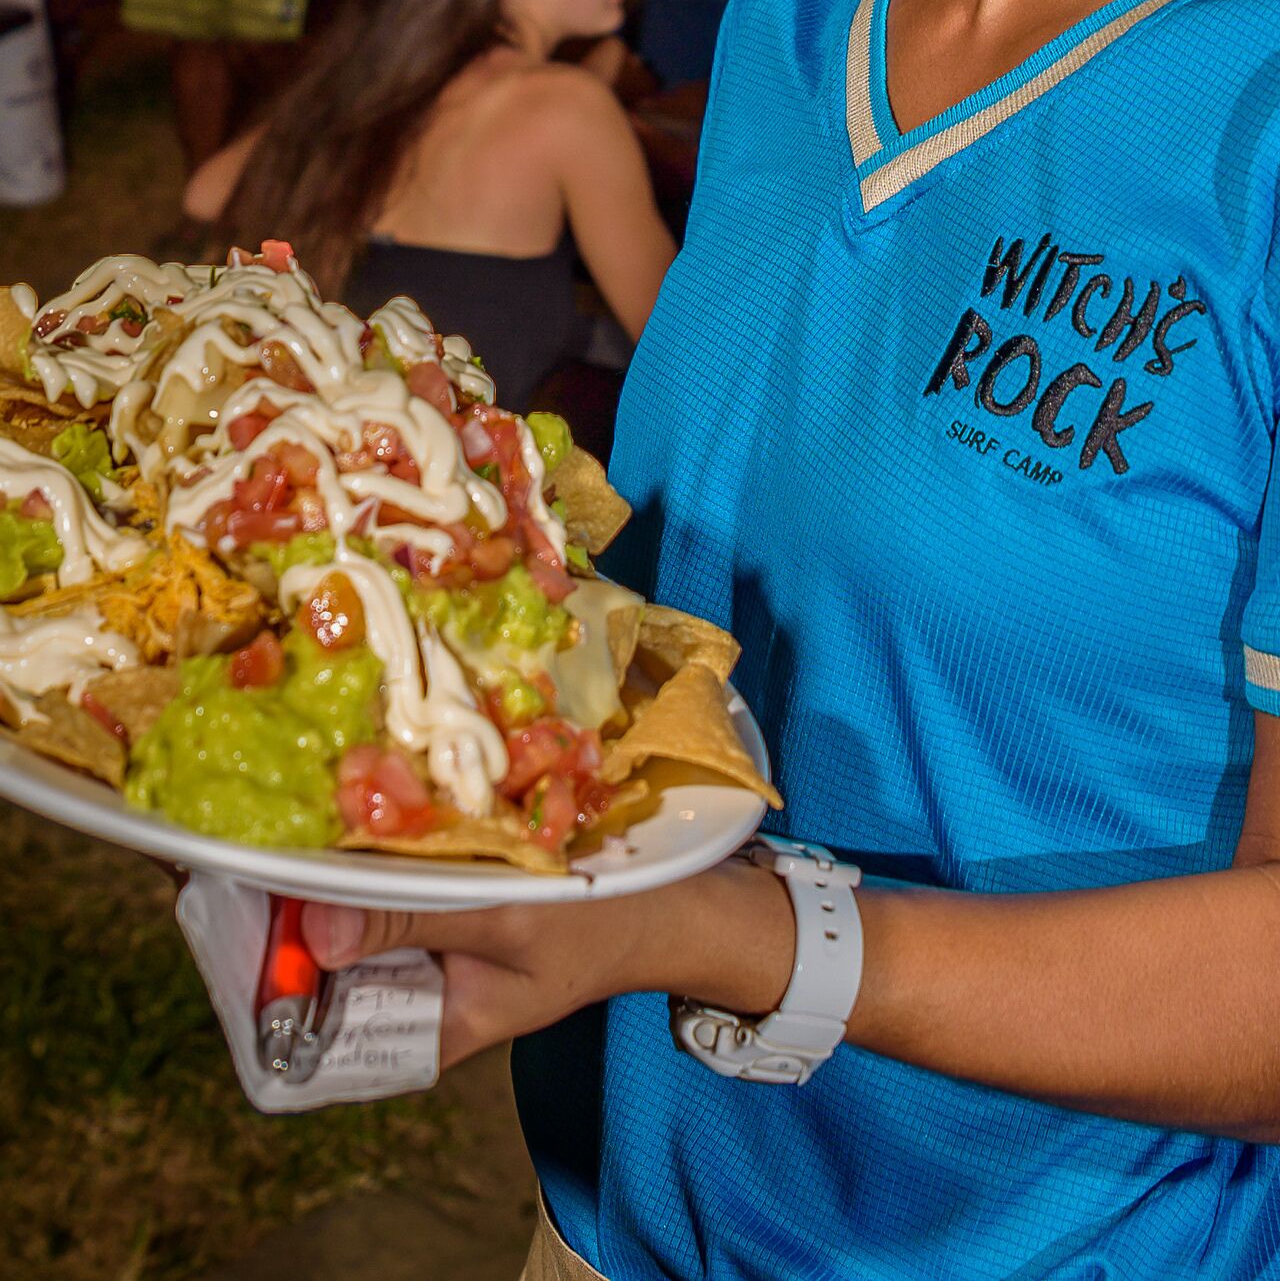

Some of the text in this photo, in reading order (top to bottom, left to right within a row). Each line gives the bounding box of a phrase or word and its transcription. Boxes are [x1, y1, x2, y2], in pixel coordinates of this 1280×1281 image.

[922, 306, 1155, 475] ROCK
[946, 420, 1064, 487] SURF CAMP
